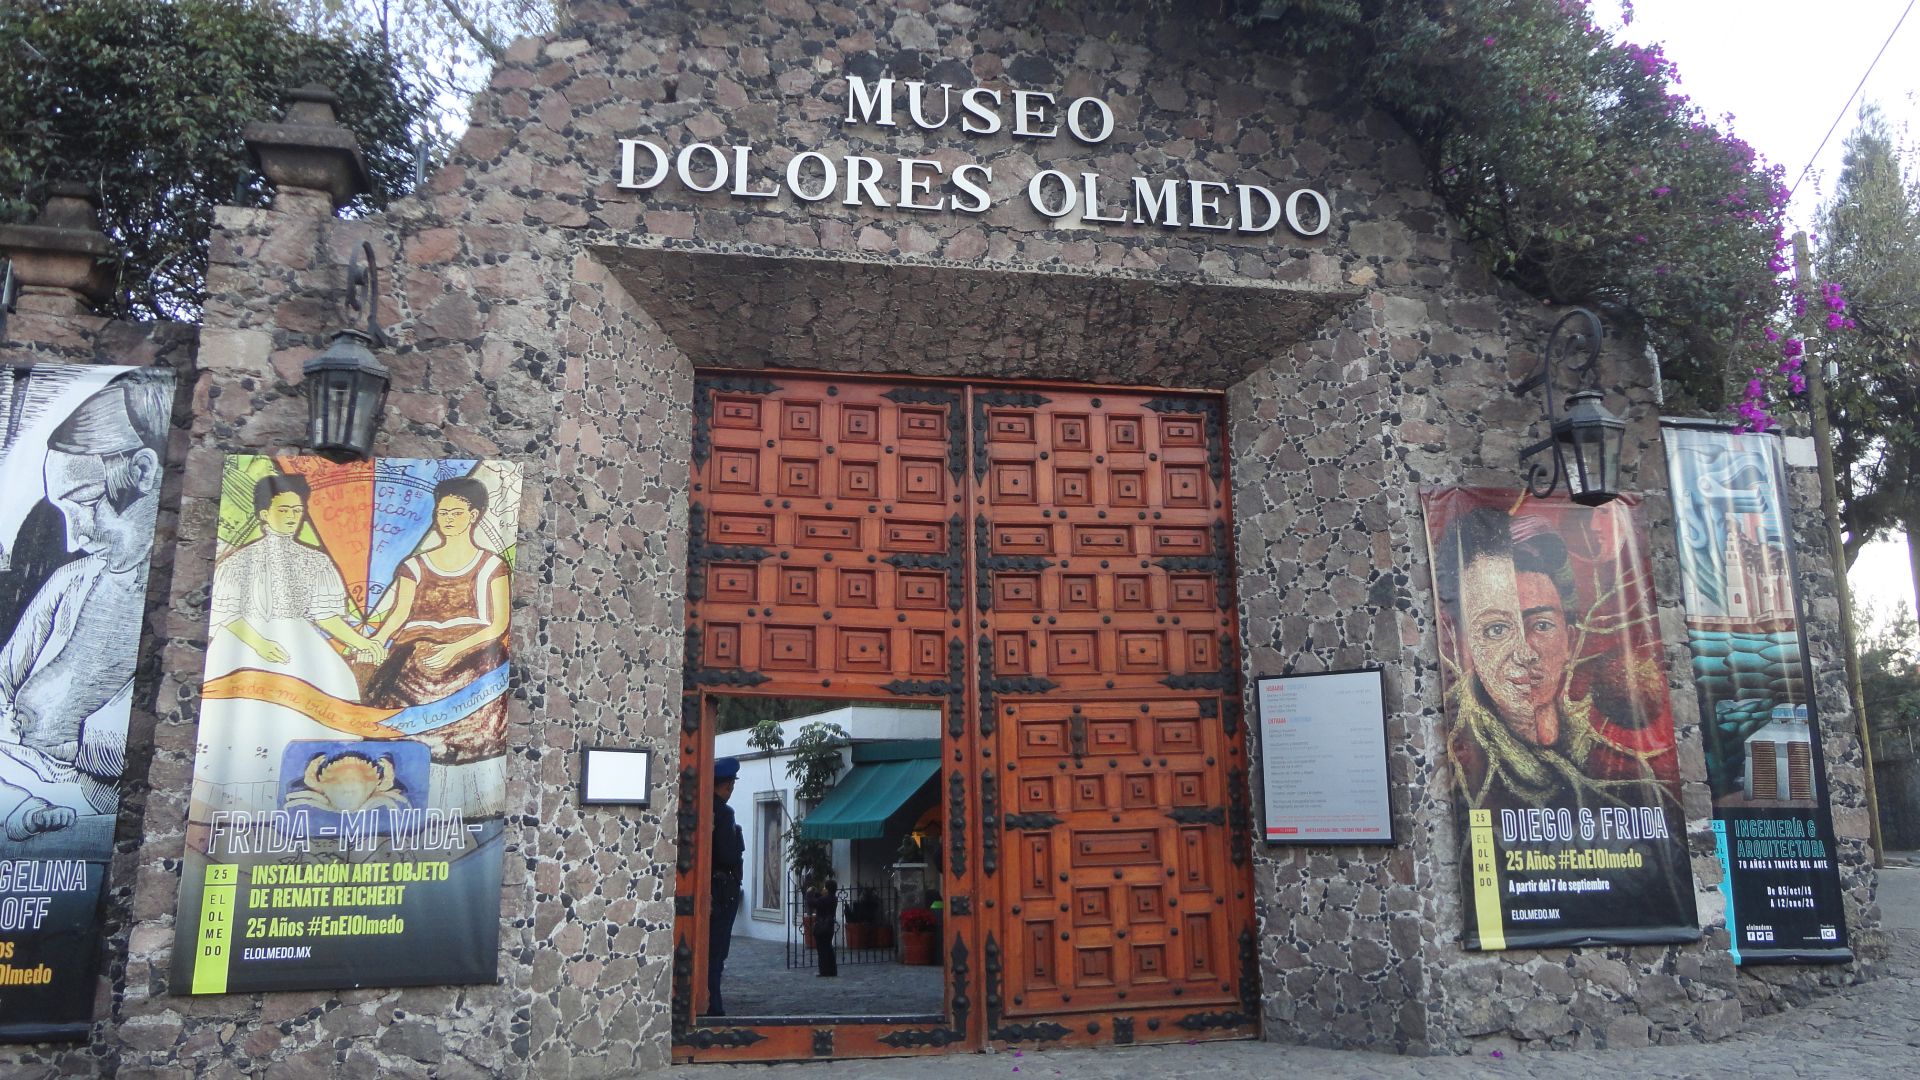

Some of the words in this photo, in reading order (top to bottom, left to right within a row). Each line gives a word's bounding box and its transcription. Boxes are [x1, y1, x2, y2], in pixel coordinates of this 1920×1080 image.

[844, 75, 1115, 144] MUSEO
[616, 138, 993, 213] DOLORES
[1028, 169, 1331, 237] OLMEDO
[208, 810, 310, 854] FRIDA
[1501, 807, 1573, 841] DIEGO
[1578, 807, 1595, 840] &
[1599, 806, 1669, 840] FRIDA
[1734, 816, 1805, 838] INGENIERÍA
[1806, 819, 1816, 838] &
[1505, 850, 1524, 871] 25
[1526, 850, 1556, 871] Años
[1558, 847, 1643, 870] #EnElOlmedo
[1737, 839, 1826, 860] ARQUITECTURA
[251, 859, 350, 885] INSTALACIÓN
[351, 863, 390, 884] ARTE
[392, 861, 449, 882] OBJETO
[1738, 860, 1748, 869] 70
[1749, 858, 1767, 869] AÑOS
[1768, 860, 1773, 869] A
[1773, 858, 1799, 869] TRAVÉS
[1800, 860, 1811, 869] DEL
[1813, 860, 1829, 869] ARTE
[249, 888, 270, 908] DE
[271, 886, 329, 908] RENATE
[329, 885, 405, 907] REICHERT
[1508, 880, 1516, 893] A
[1516, 880, 1537, 896] partir
[1538, 878, 1551, 893] del
[1550, 878, 1557, 892] 7
[1557, 878, 1568, 892] de
[1568, 877, 1610, 894] septiembre
[1766, 886, 1776, 896] De
[1770, 898, 1775, 908] A
[1511, 908, 1560, 921] ELOLMEDO.MX
[246, 917, 266, 938] 25
[268, 916, 304, 938] Años
[307, 914, 404, 936] #EnElOlmedo
[1822, 930, 1835, 938] ICA
[244, 946, 311, 960] ELOLMEDO.MX
